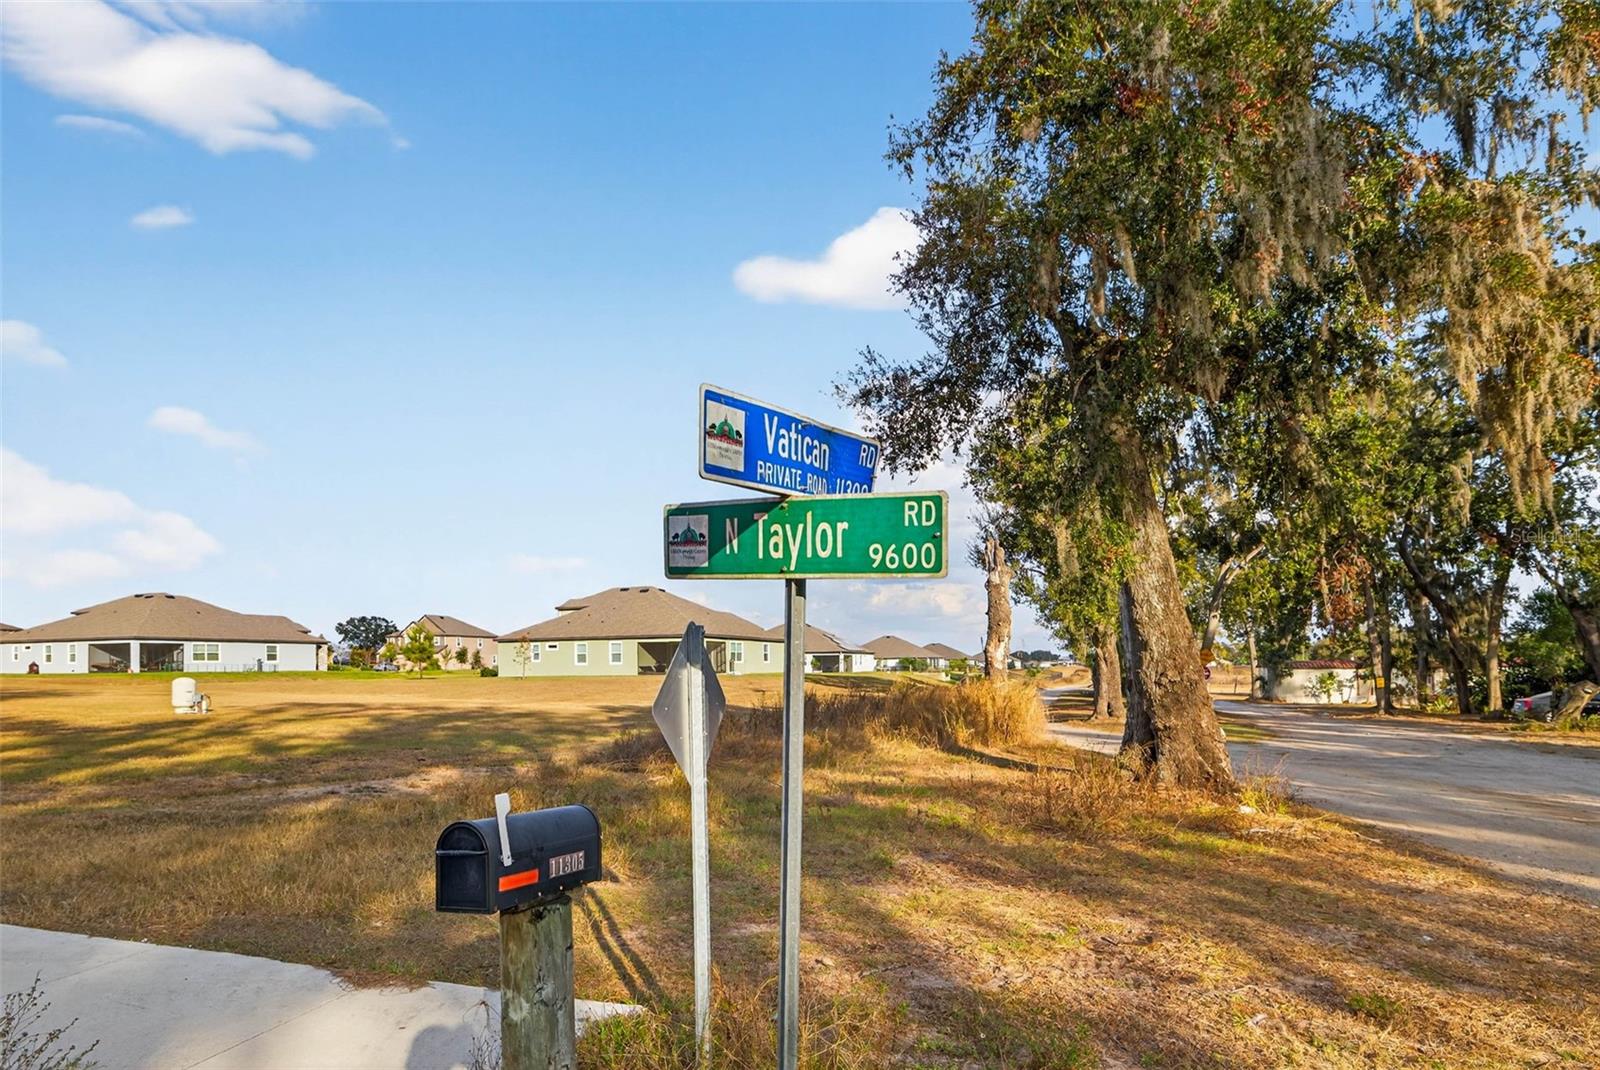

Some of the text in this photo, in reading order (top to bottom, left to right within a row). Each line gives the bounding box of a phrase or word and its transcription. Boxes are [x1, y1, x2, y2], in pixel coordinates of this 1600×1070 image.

[763, 412, 875, 472] Vatican RD
[757, 460, 802, 490] PRIVATE
[807, 472, 827, 495] ROAD
[725, 500, 937, 570] N Taylor RD
[868, 542, 936, 570] 9600
[550, 852, 584, 878] 11305
